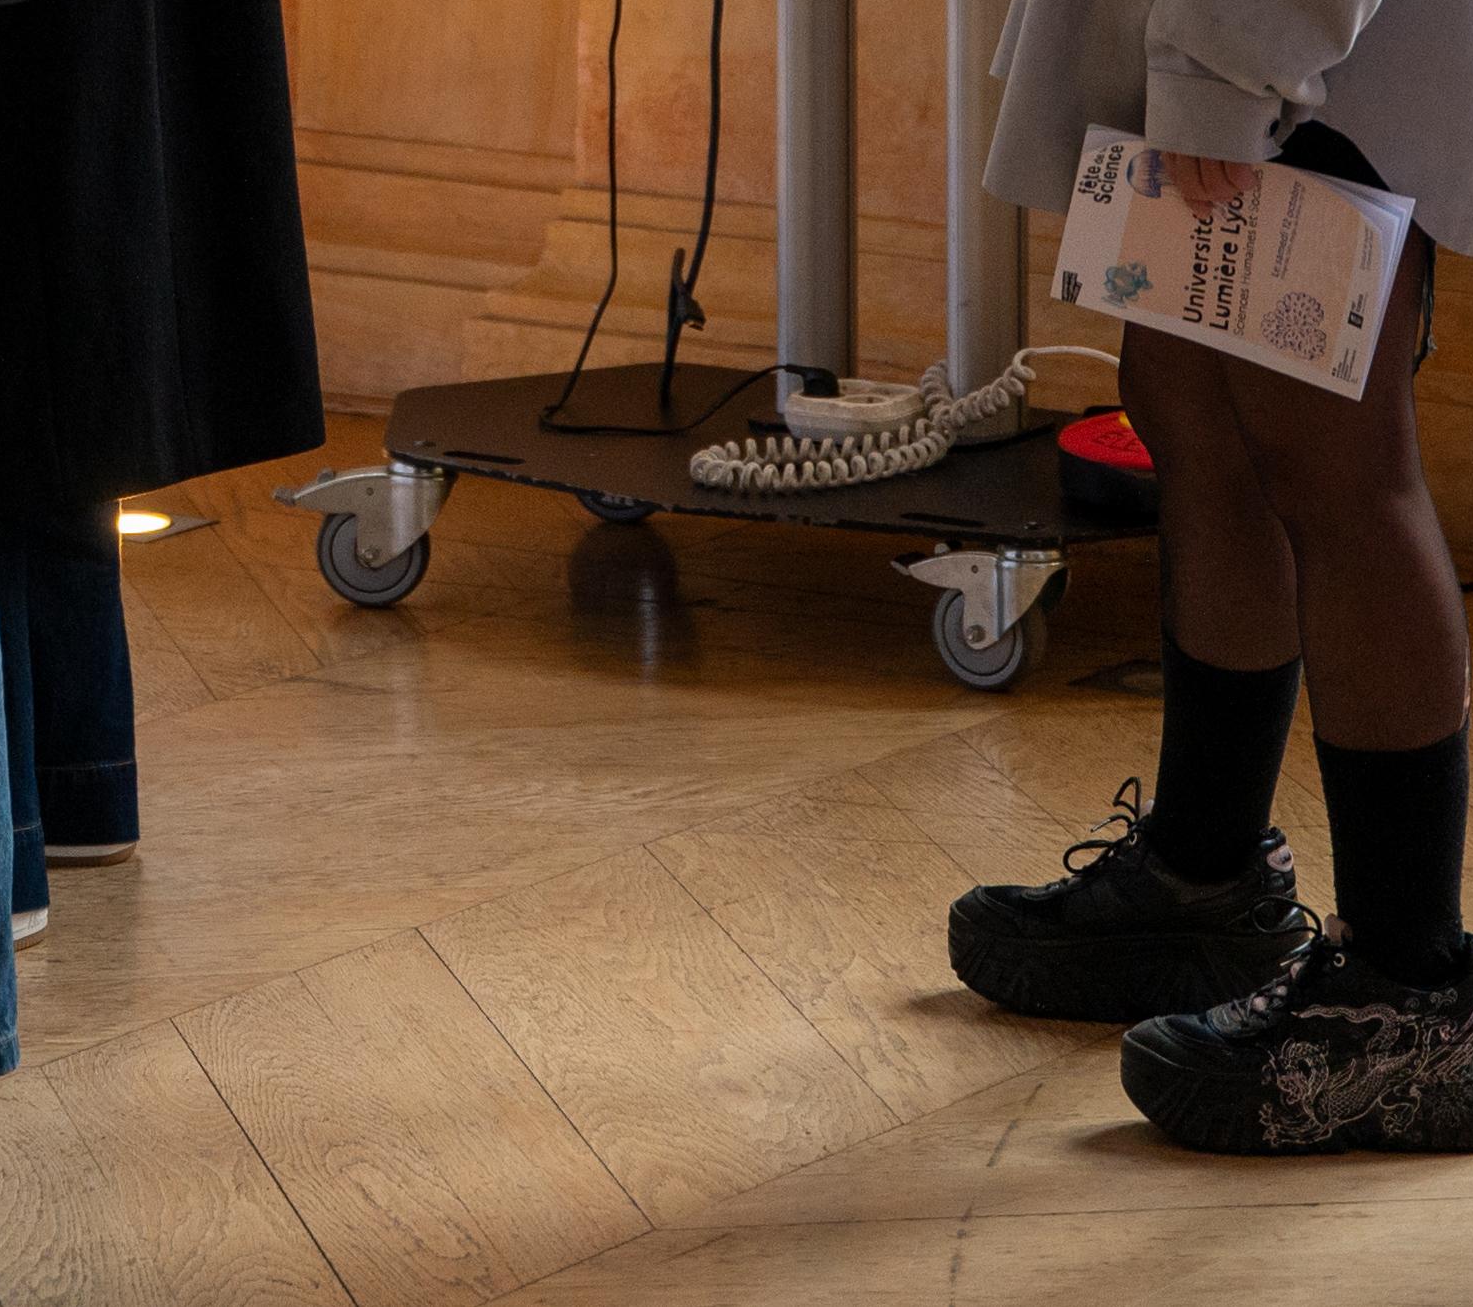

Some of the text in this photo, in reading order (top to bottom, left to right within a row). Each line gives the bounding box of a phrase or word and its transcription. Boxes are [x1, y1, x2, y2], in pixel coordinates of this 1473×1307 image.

[1077, 165, 1102, 196] fête
[1093, 144, 1124, 205] Science
[1209, 192, 1248, 331] Lumière Lyo
[1275, 232, 1288, 266] samedi
[1233, 288, 1250, 336] Sciences
[1242, 234, 1257, 285] Humaines
